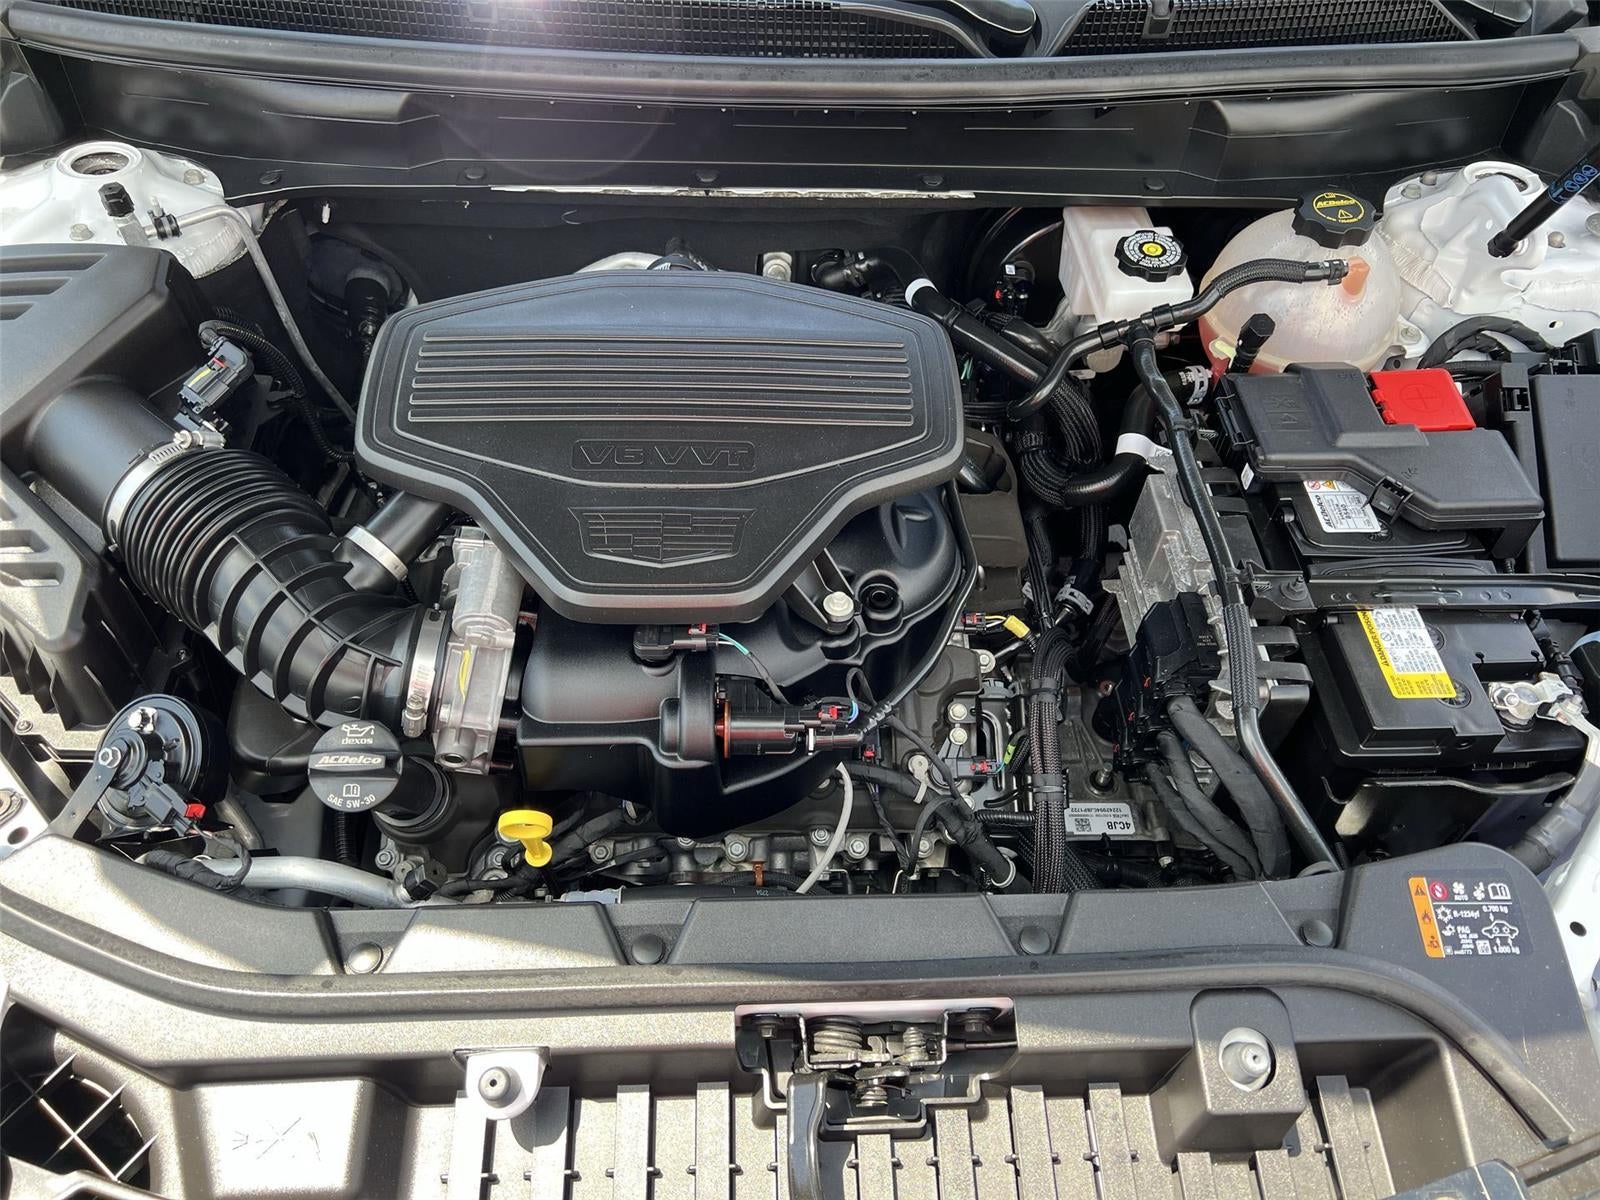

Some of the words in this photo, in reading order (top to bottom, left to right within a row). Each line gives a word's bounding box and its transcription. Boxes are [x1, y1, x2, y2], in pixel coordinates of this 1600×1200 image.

[1316, 199, 1356, 209] ACDelco
[580, 445, 644, 465] V6
[654, 445, 749, 466] VVT
[1314, 494, 1334, 529] ACDelco
[341, 737, 374, 745] dexos
[317, 755, 382, 765] ACDelco
[327, 794, 344, 807] SAE
[346, 794, 376, 809] 5W-30
[1106, 821, 1131, 830] 4CJB
